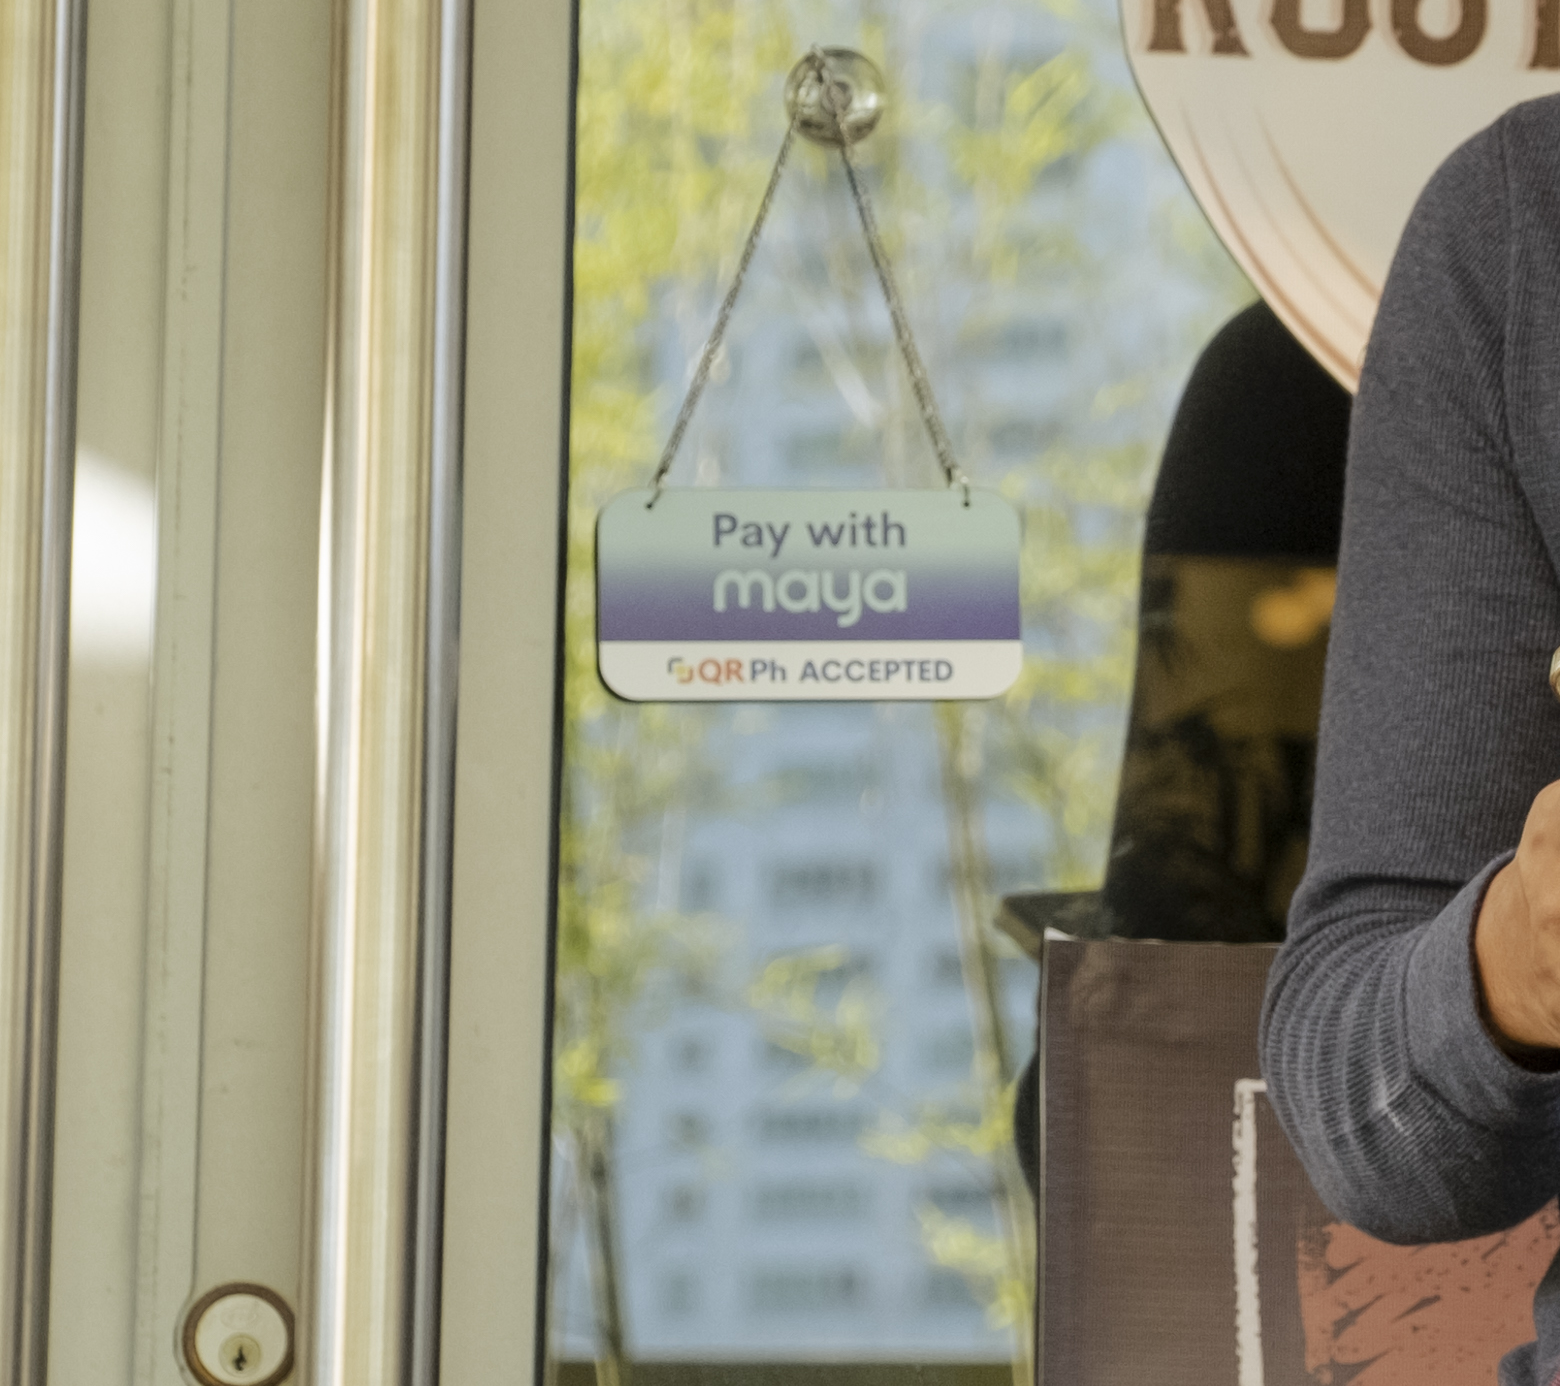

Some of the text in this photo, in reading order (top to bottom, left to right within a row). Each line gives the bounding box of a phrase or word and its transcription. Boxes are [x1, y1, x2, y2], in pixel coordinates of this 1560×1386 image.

[713, 512, 907, 559] Pay with
[712, 569, 908, 628] maya
[800, 660, 953, 682] ACCEPTED
